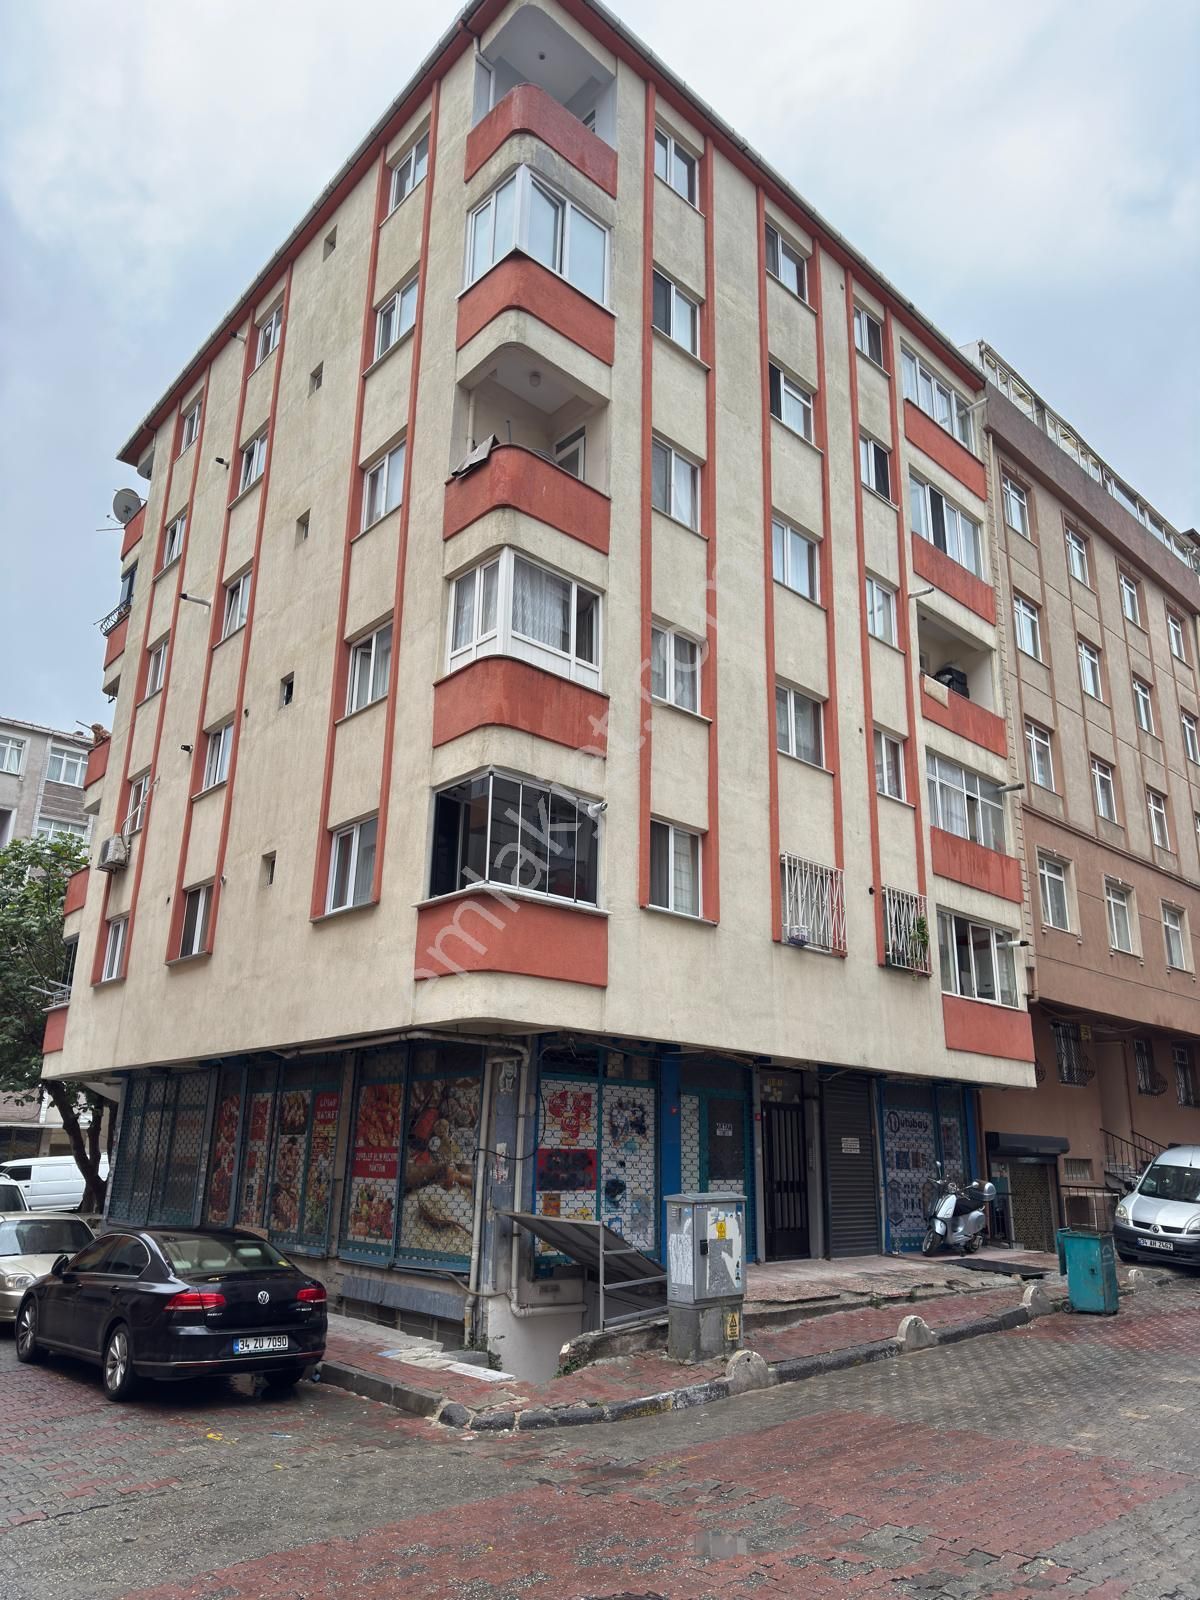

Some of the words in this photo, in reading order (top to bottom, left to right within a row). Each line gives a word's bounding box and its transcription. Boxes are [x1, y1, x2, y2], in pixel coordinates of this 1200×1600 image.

[239, 1339, 250, 1350] 34
[253, 1338, 264, 1349] ZU
[267, 1336, 287, 1348] 7090
